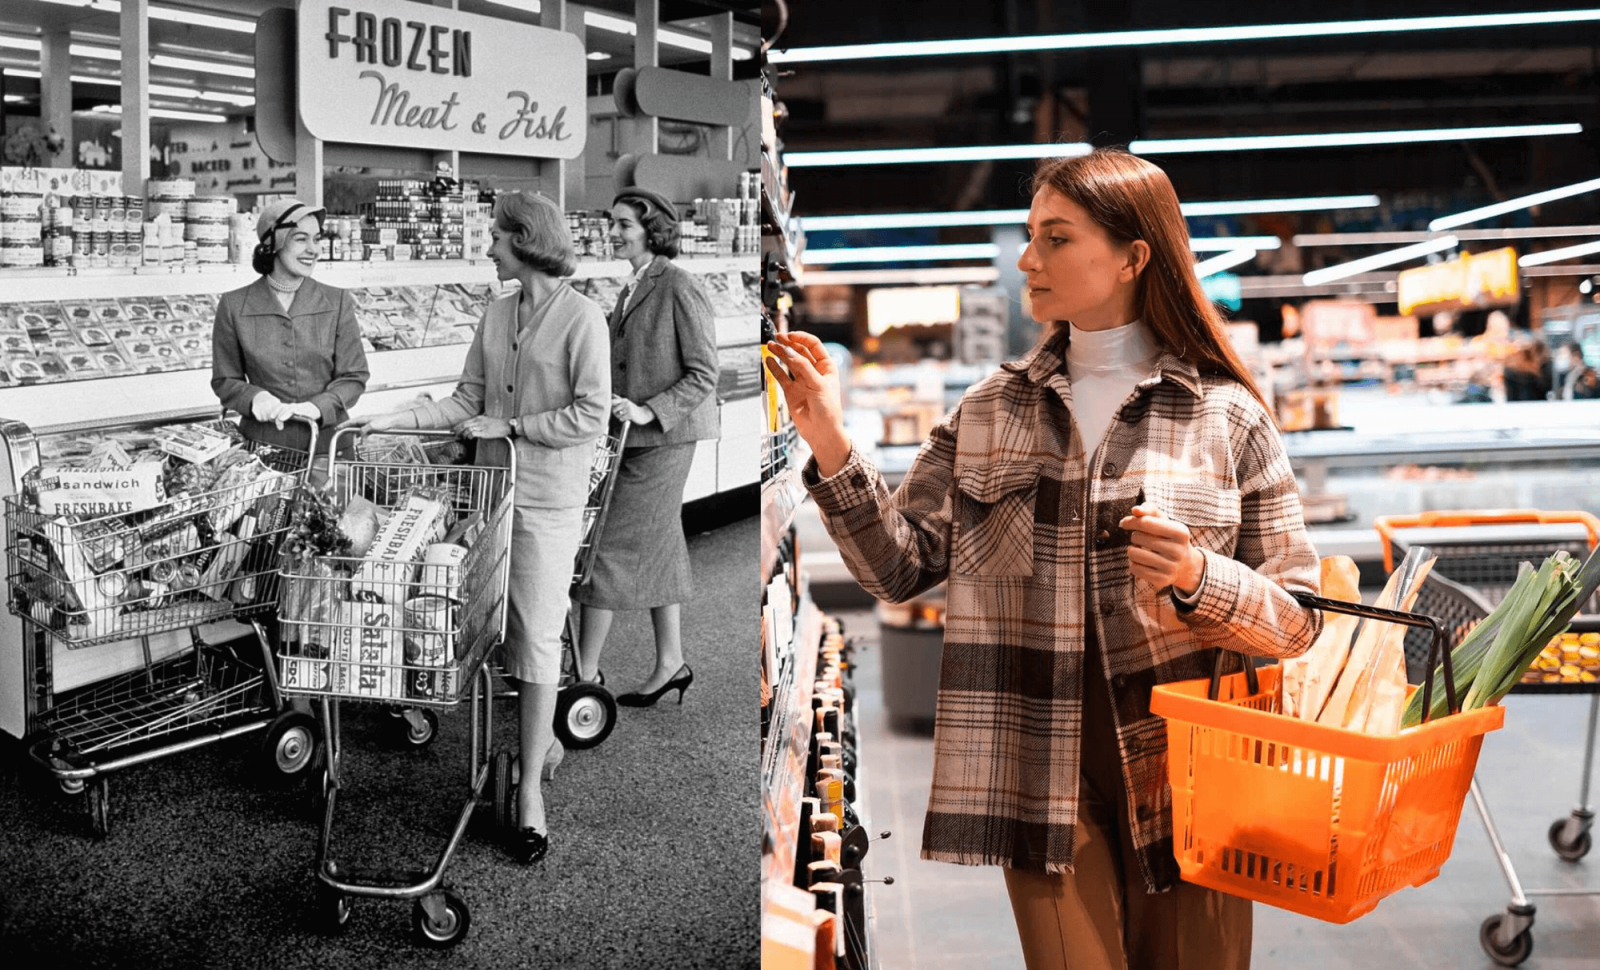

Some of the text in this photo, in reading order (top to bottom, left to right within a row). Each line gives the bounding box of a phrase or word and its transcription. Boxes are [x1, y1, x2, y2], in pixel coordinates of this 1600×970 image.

[325, 6, 472, 78] FROZEN
[359, 70, 572, 141] Meat & Fish
[54, 501, 133, 515] FRESHBAKE
[63, 478, 140, 490] sandwich
[355, 512, 397, 575] sandwih
[359, 611, 390, 690] Salada
